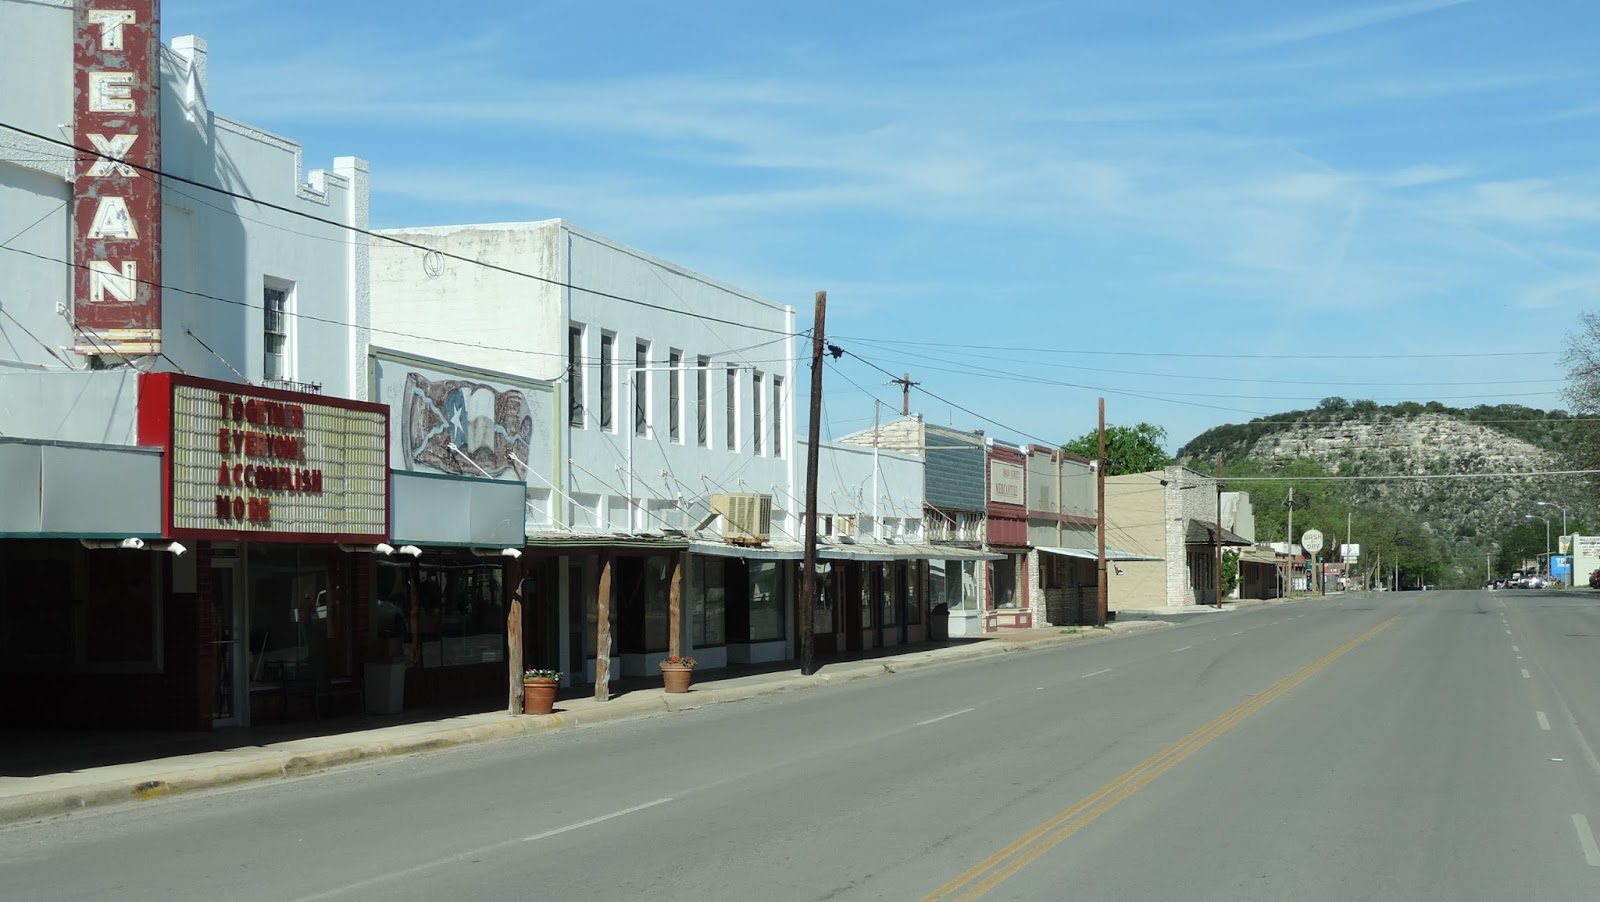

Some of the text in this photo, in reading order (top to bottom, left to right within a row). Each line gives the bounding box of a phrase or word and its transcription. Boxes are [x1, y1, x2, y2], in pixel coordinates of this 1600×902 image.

[86, 9, 141, 302] TEXAN
[218, 394, 304, 428] TOGETHER
[218, 428, 305, 460] EVERYONE
[218, 461, 322, 492] ACCOMPLISH
[995, 482, 1017, 498] MERCANTILE
[216, 495, 270, 522] MORE
